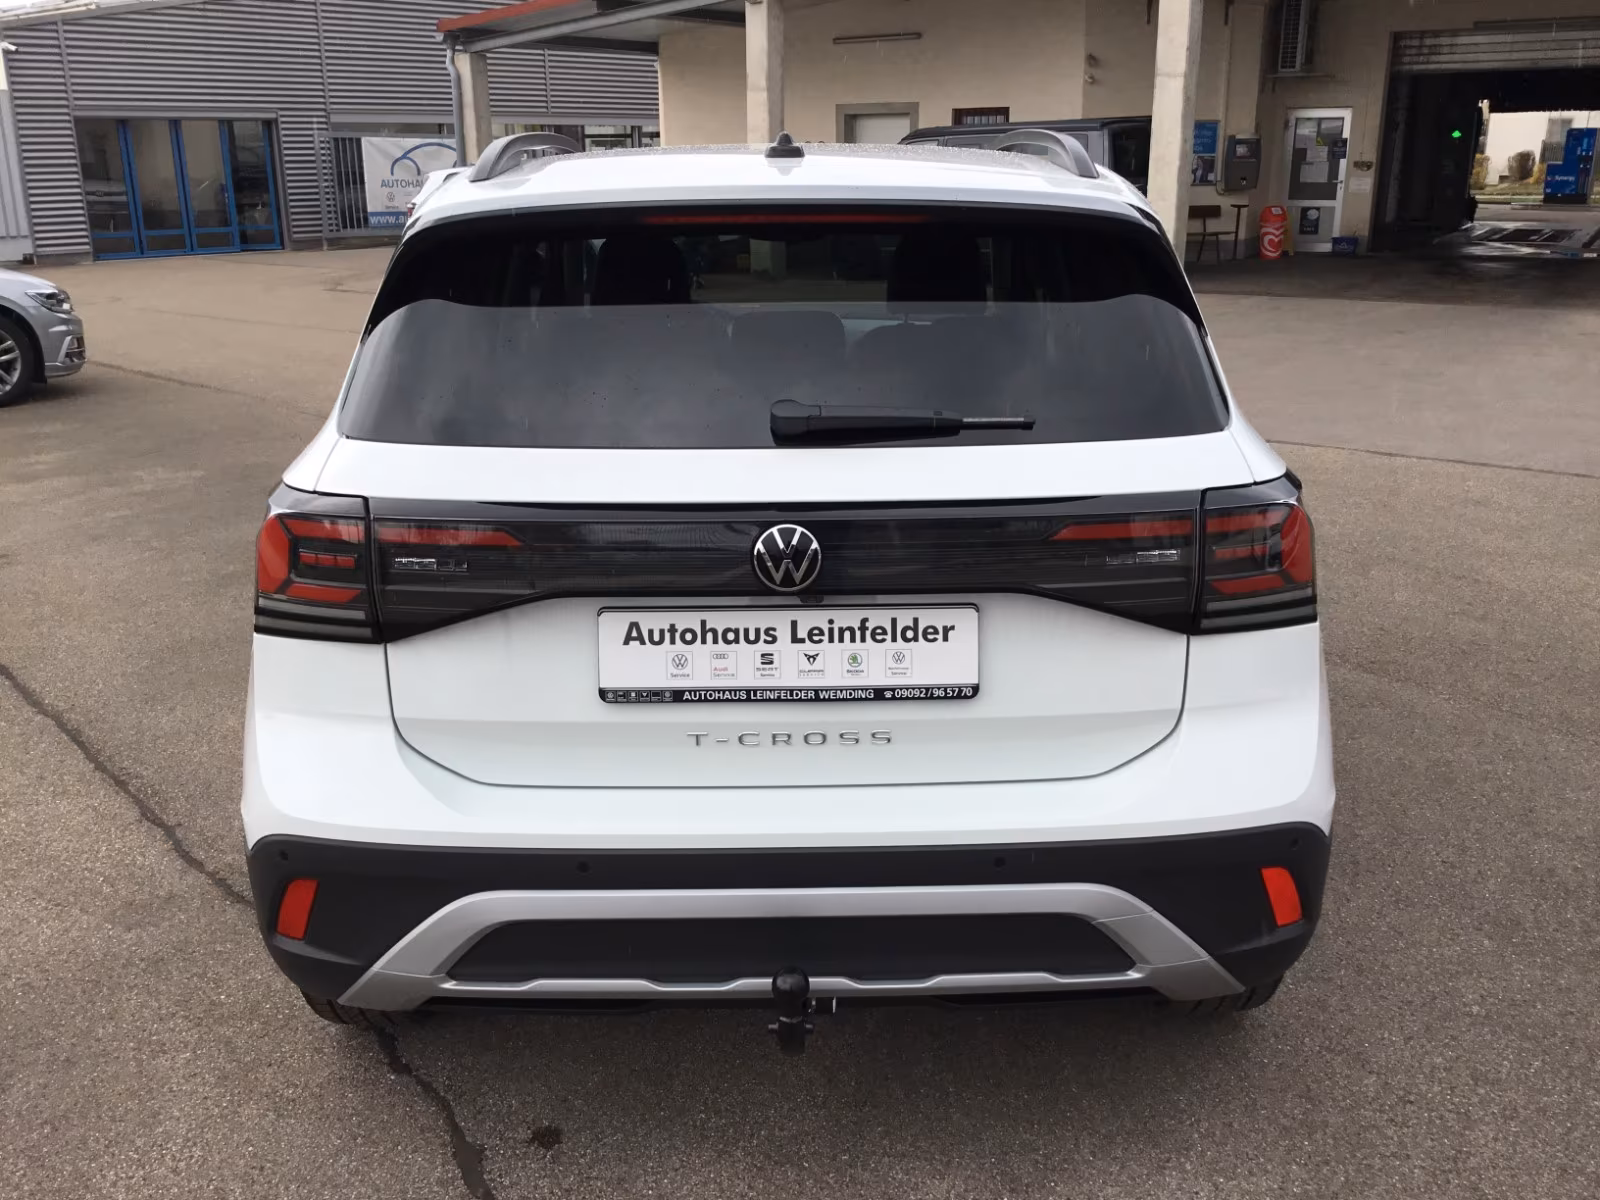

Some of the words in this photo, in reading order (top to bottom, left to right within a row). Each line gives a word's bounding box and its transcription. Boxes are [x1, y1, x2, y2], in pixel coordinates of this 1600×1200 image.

[380, 178, 424, 189] AUTOHA
[622, 619, 778, 646] Autohaus
[790, 617, 955, 644] Leinfelder
[683, 690, 747, 700] AUTOHAUS
[750, 689, 815, 699] LEINFELDER
[818, 689, 874, 699] WEMDING
[686, 729, 892, 747] T-CROSS
